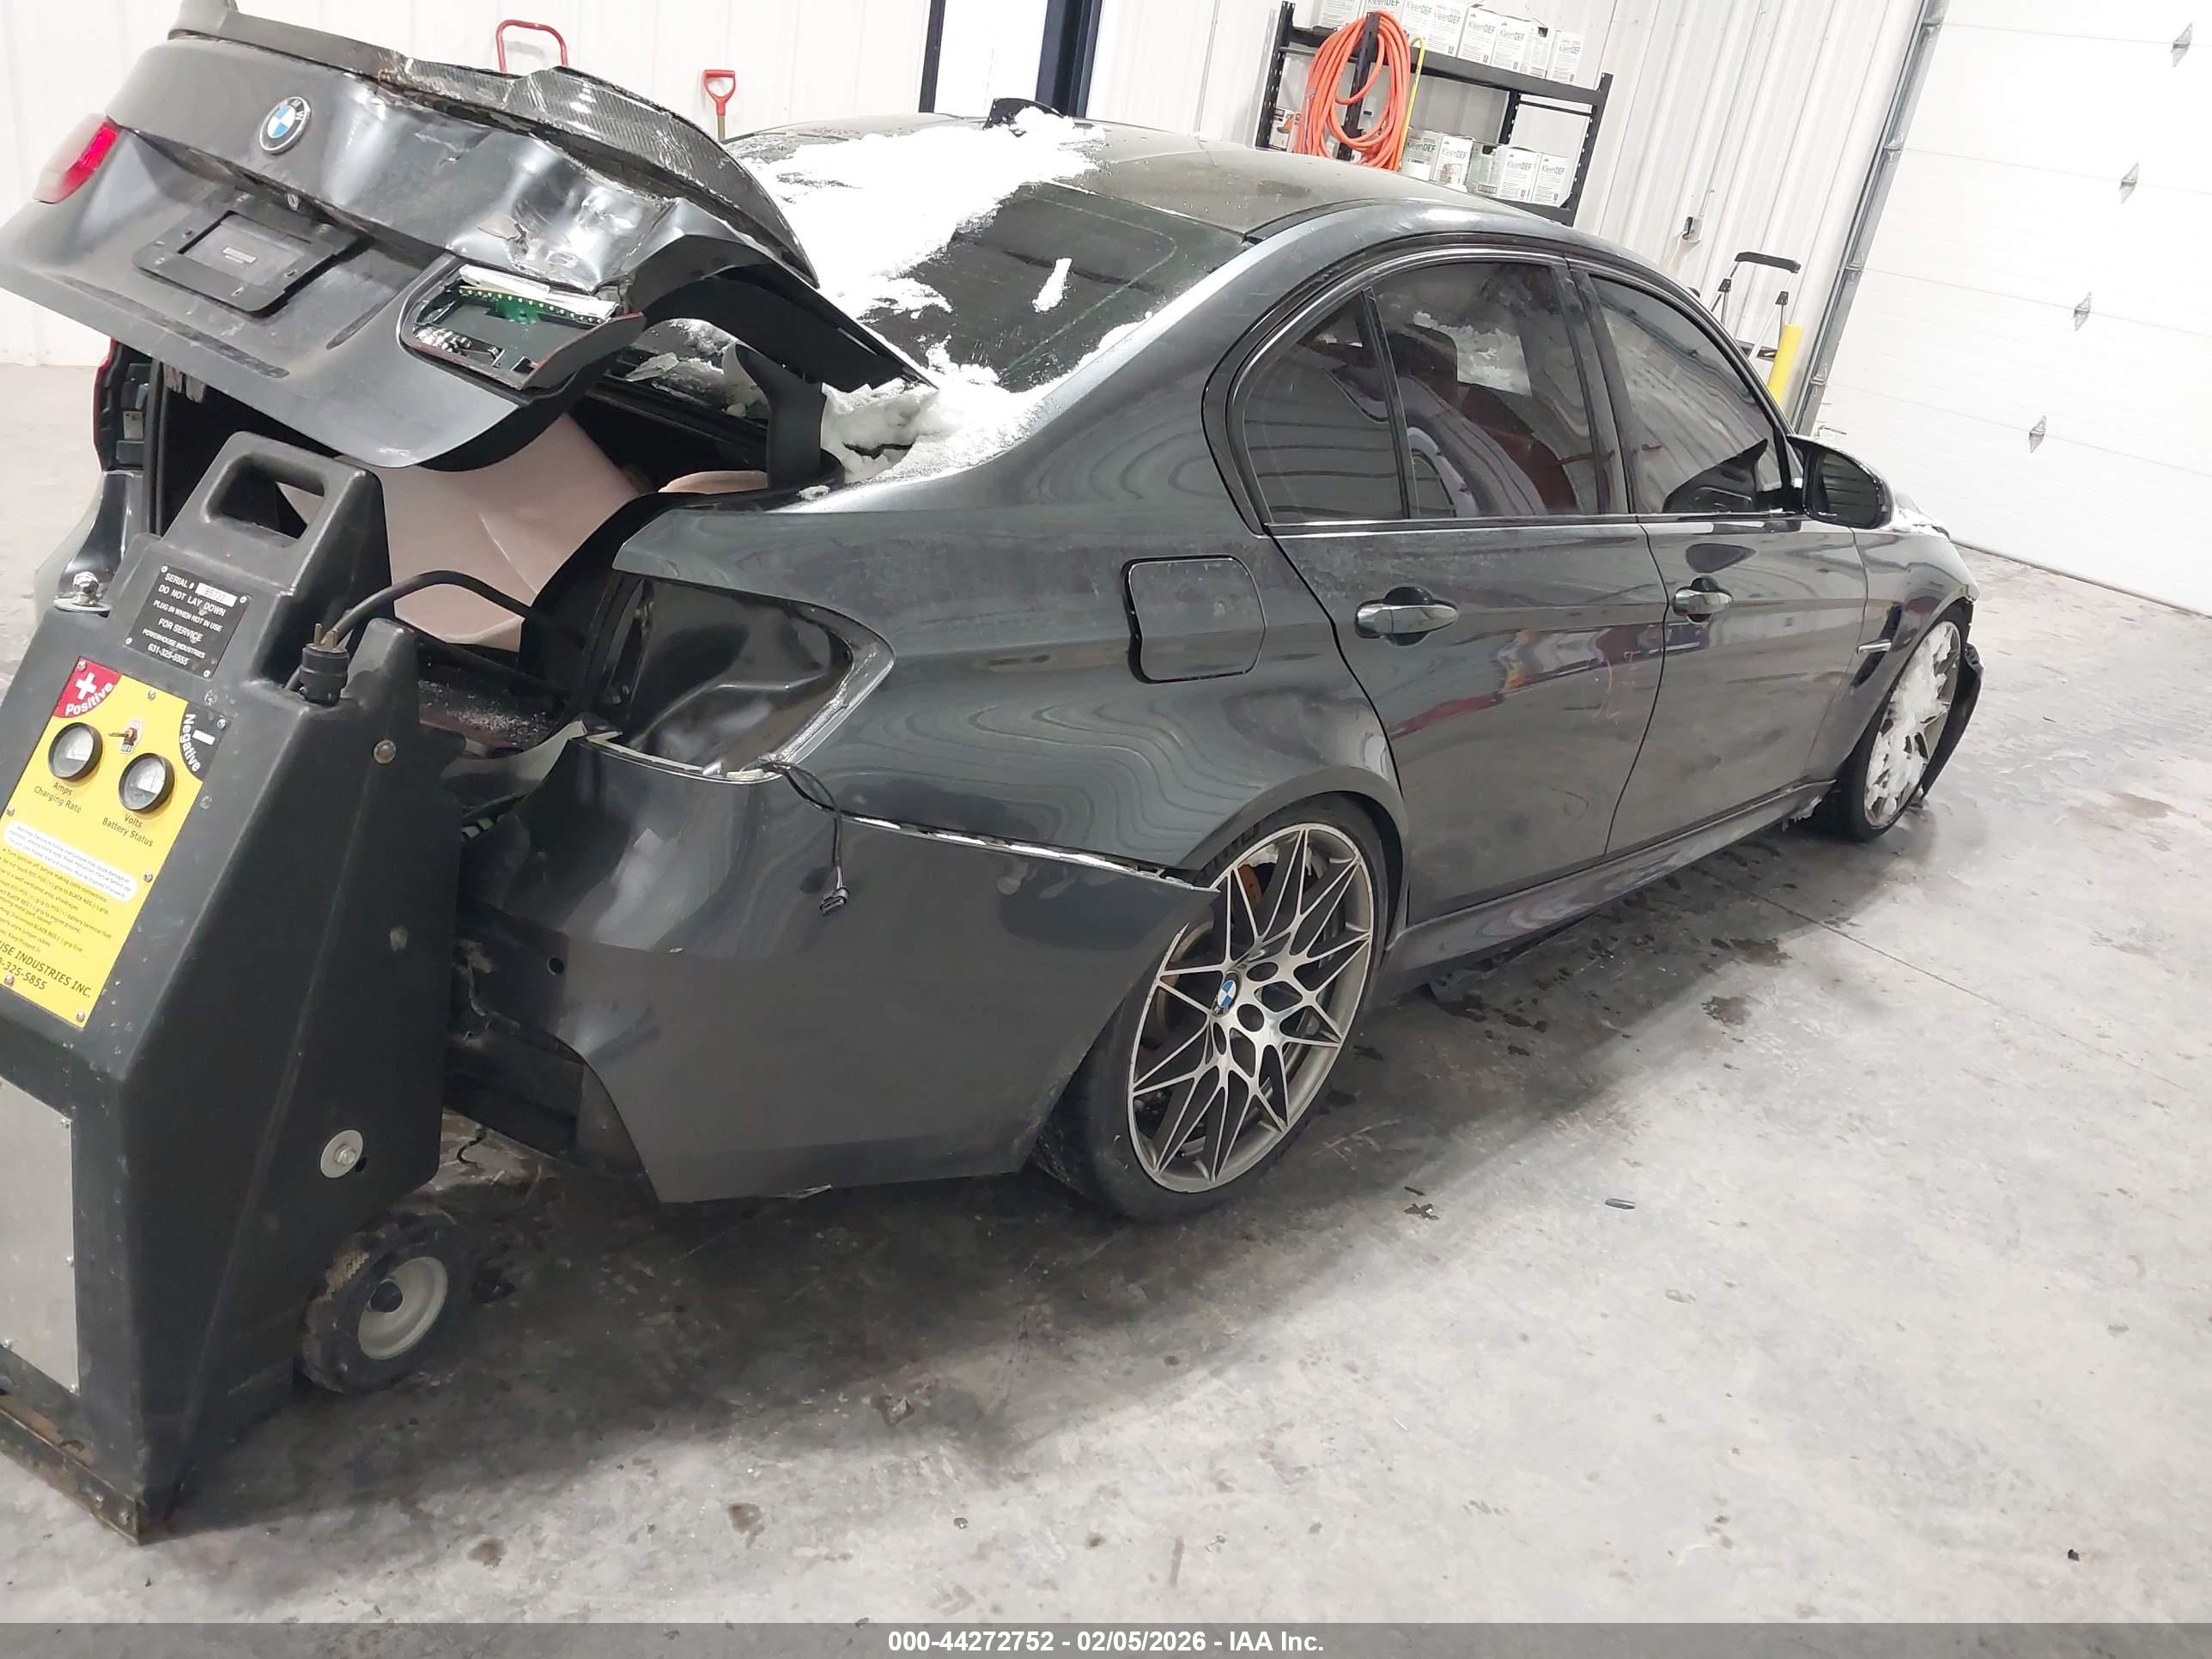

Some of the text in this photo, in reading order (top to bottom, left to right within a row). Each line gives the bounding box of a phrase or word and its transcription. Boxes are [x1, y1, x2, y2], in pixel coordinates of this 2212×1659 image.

[164, 573, 188, 588] SERIAL
[158, 584, 227, 617] DO NOT LAY DOWN
[153, 599, 168, 611] PLUG
[174, 608, 191, 620] WHEN
[191, 614, 205, 625] NOT
[203, 619, 210, 628] IN
[209, 622, 223, 633] USE
[158, 617, 204, 642] FOR SERVICE
[143, 628, 206, 659] POWERHOUSE INDUSTRIES
[64, 682, 114, 717] Positive
[179, 714, 201, 773] Negative
[33, 785, 82, 814] Charging Rate
[52, 781, 73, 796] Amps
[102, 817, 154, 847] Battery Status
[125, 812, 143, 829] Volts
[15, 951, 72, 987] INDUSTRIES
[70, 981, 92, 998] INC.
